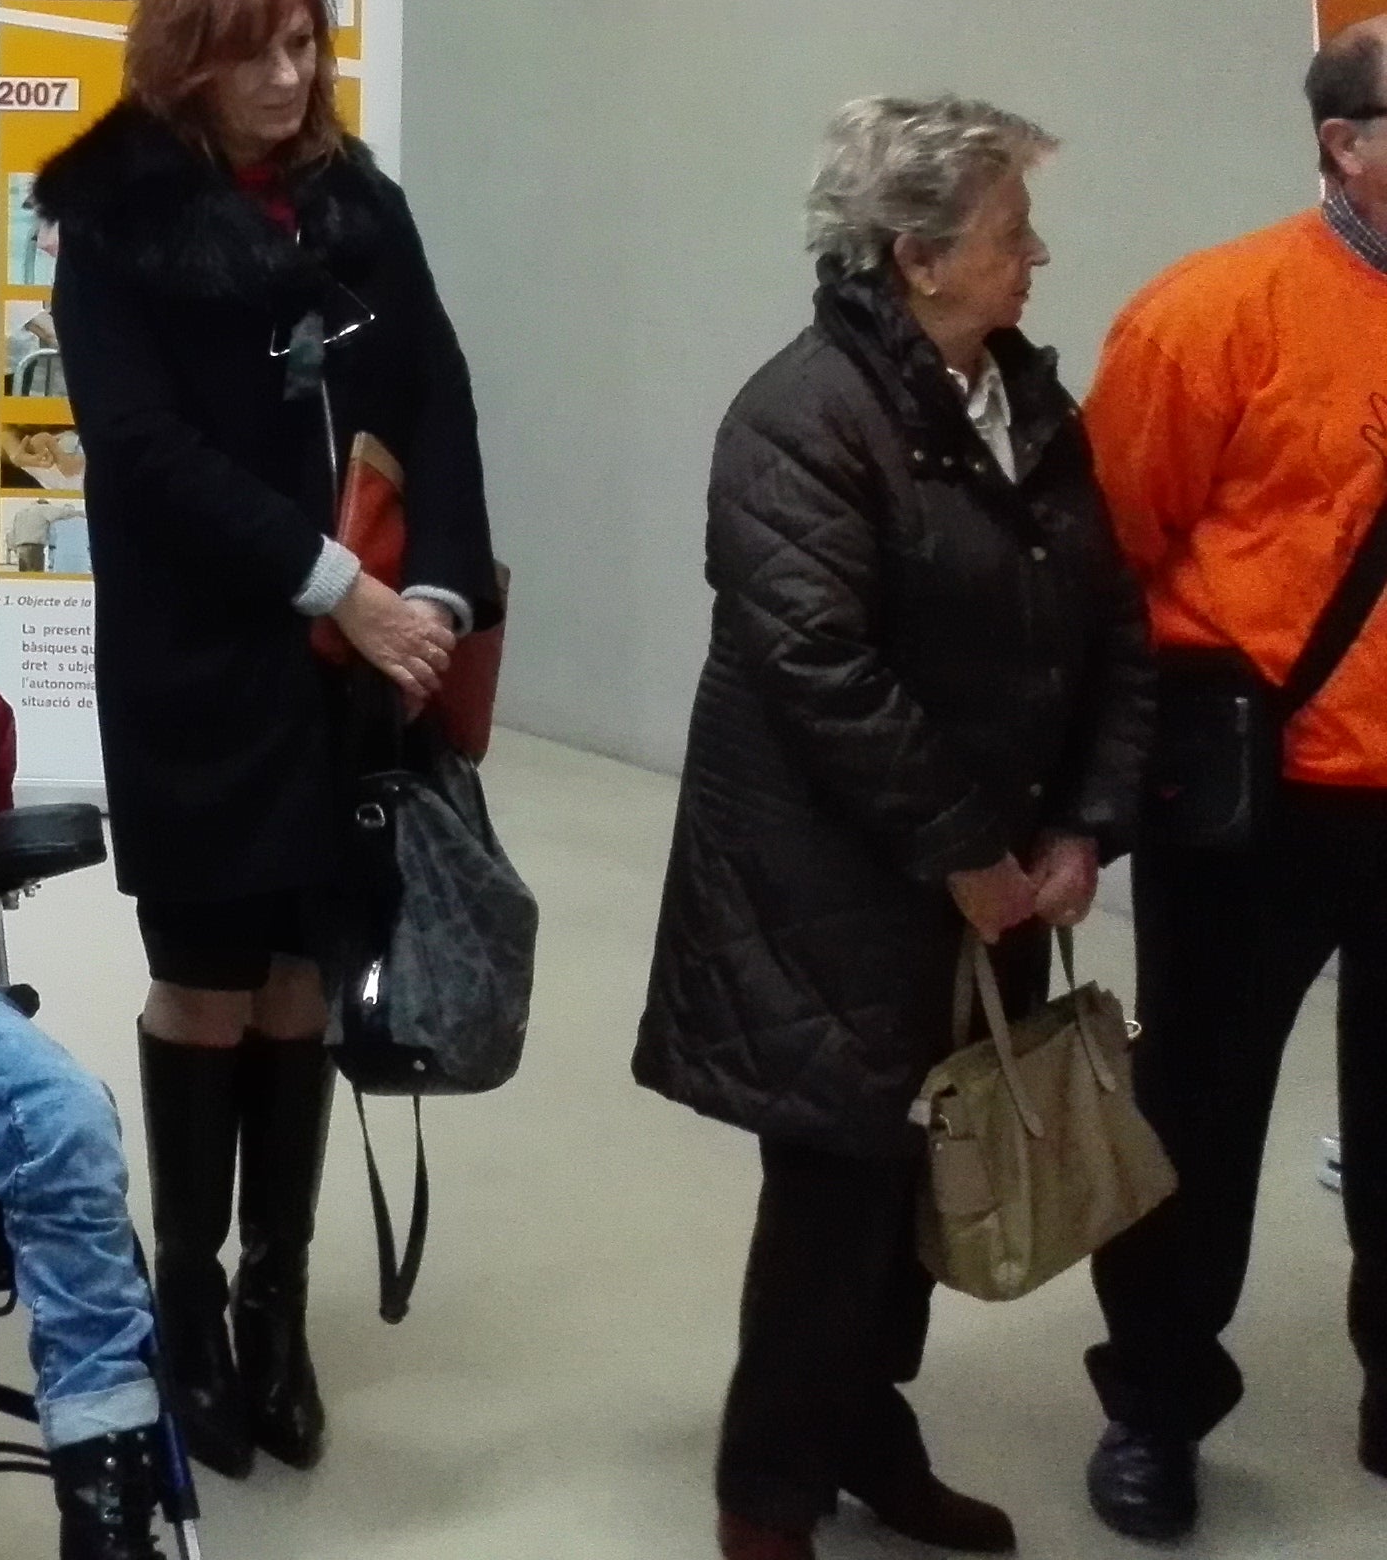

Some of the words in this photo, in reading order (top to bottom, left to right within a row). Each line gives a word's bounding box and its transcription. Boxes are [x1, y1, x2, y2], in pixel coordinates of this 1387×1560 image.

[3, 595, 14, 606] 1.
[17, 594, 61, 608] Objecte
[64, 596, 78, 607] de
[81, 597, 93, 608] la
[22, 623, 36, 635] La
[43, 624, 92, 638] present
[22, 639, 78, 655] bàsiques
[22, 659, 48, 672] dret
[22, 695, 71, 708] situació
[77, 696, 94, 709] de
